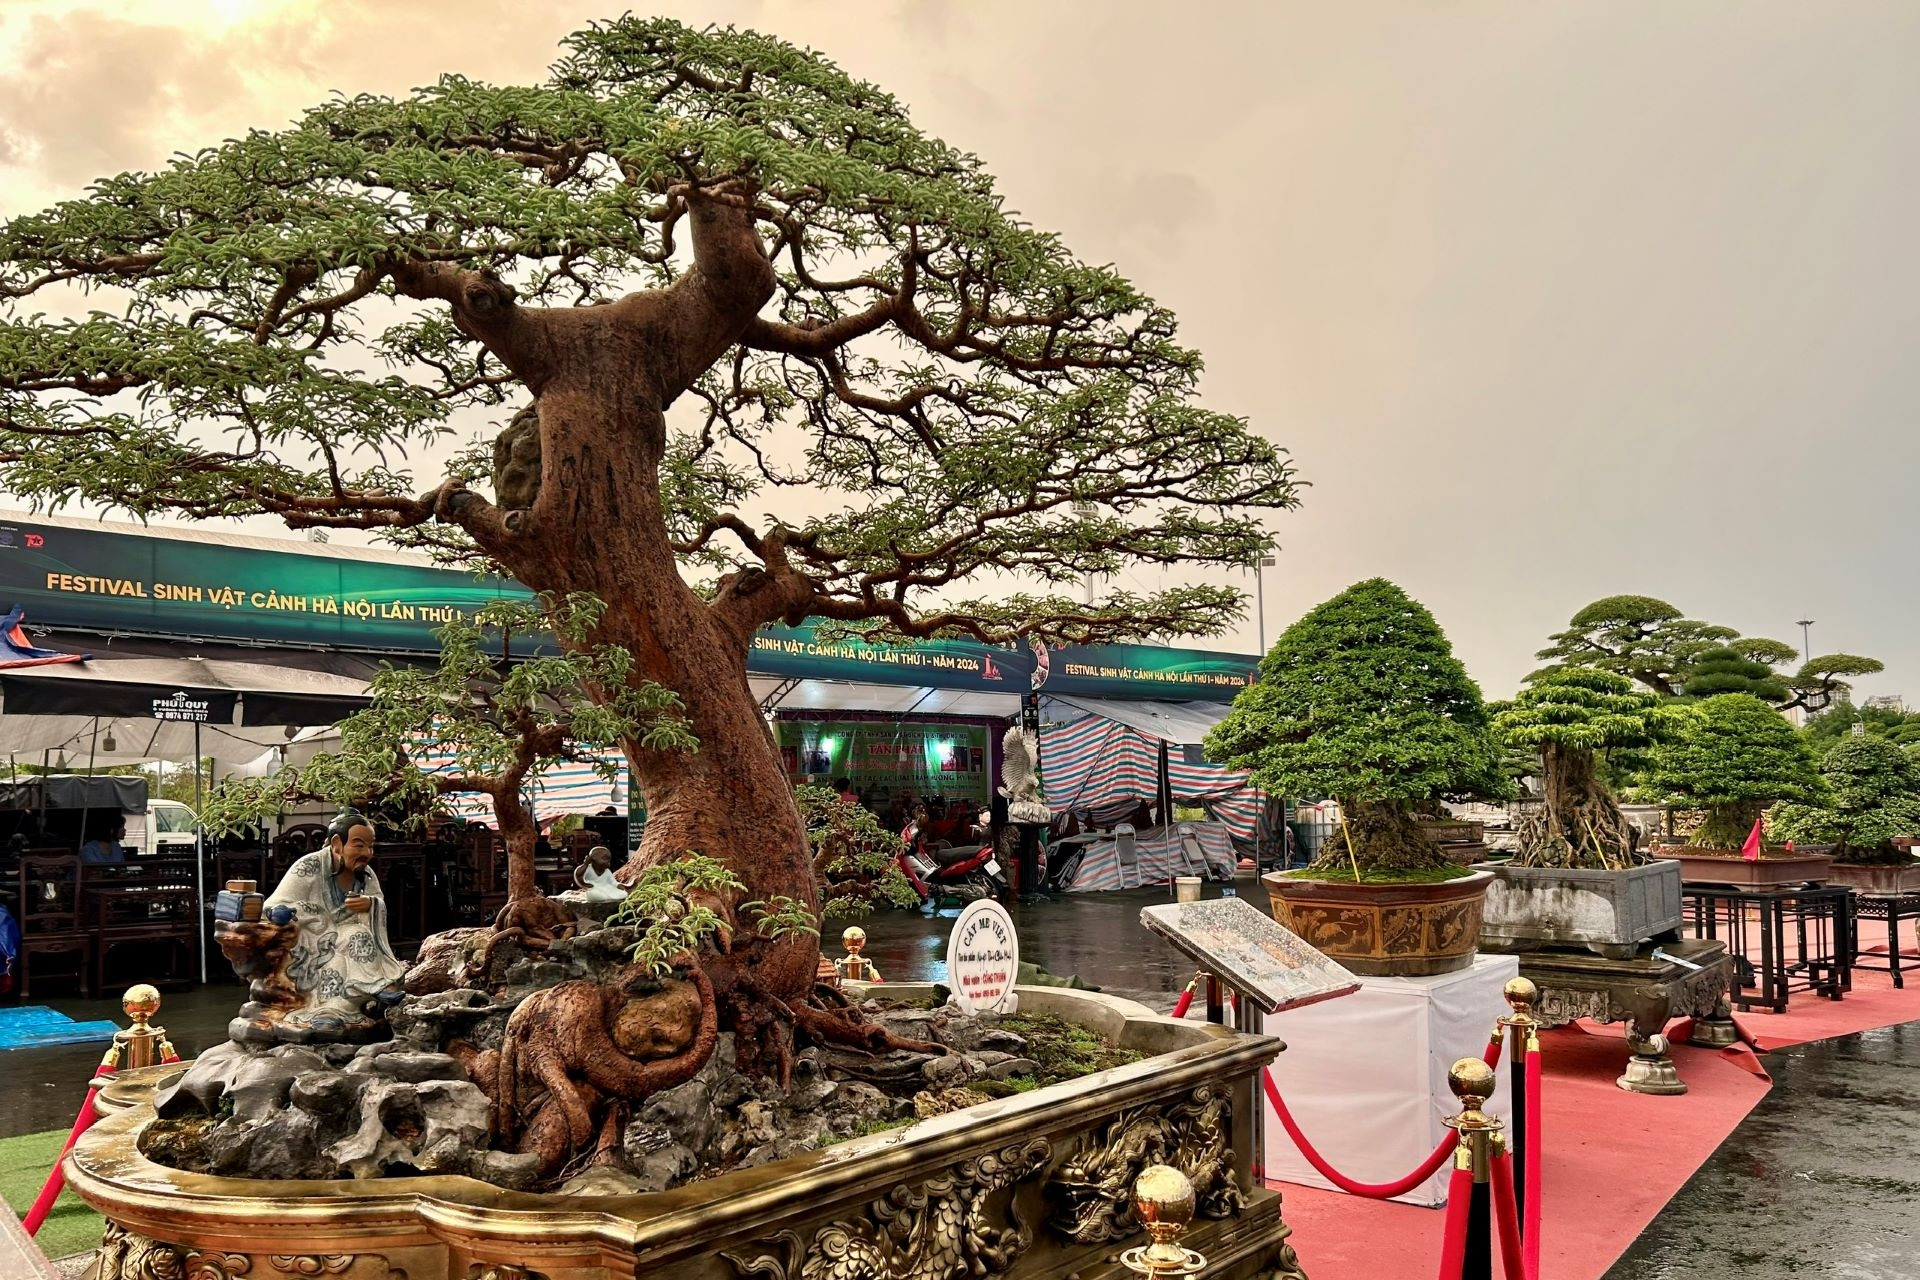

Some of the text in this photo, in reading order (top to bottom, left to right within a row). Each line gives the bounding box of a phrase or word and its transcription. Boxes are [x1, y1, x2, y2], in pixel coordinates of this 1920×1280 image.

[47, 573, 147, 598] FESTIVAL
[153, 583, 202, 602] SINH
[208, 586, 245, 610] VẬT
[250, 589, 306, 612] CẢNH
[312, 595, 339, 615] HÀ
[343, 598, 376, 621] NỘI
[381, 600, 414, 621] LẦN
[418, 605, 454, 623] THỨ
[754, 637, 781, 652] SINH
[784, 638, 805, 657] VẬT
[840, 645, 856, 660] HÀ
[858, 648, 877, 664] NỘI
[879, 648, 898, 663] LẦN
[901, 652, 921, 665] THỨ
[933, 654, 955, 669] NĂM
[956, 658, 979, 671] 2024
[1065, 664, 1099, 677] FESTIVAL
[1099, 667, 1117, 678] SINH
[1118, 667, 1133, 681] VẬT
[1133, 668, 1153, 681] CẢNH
[1230, 676, 1245, 687] 2024
